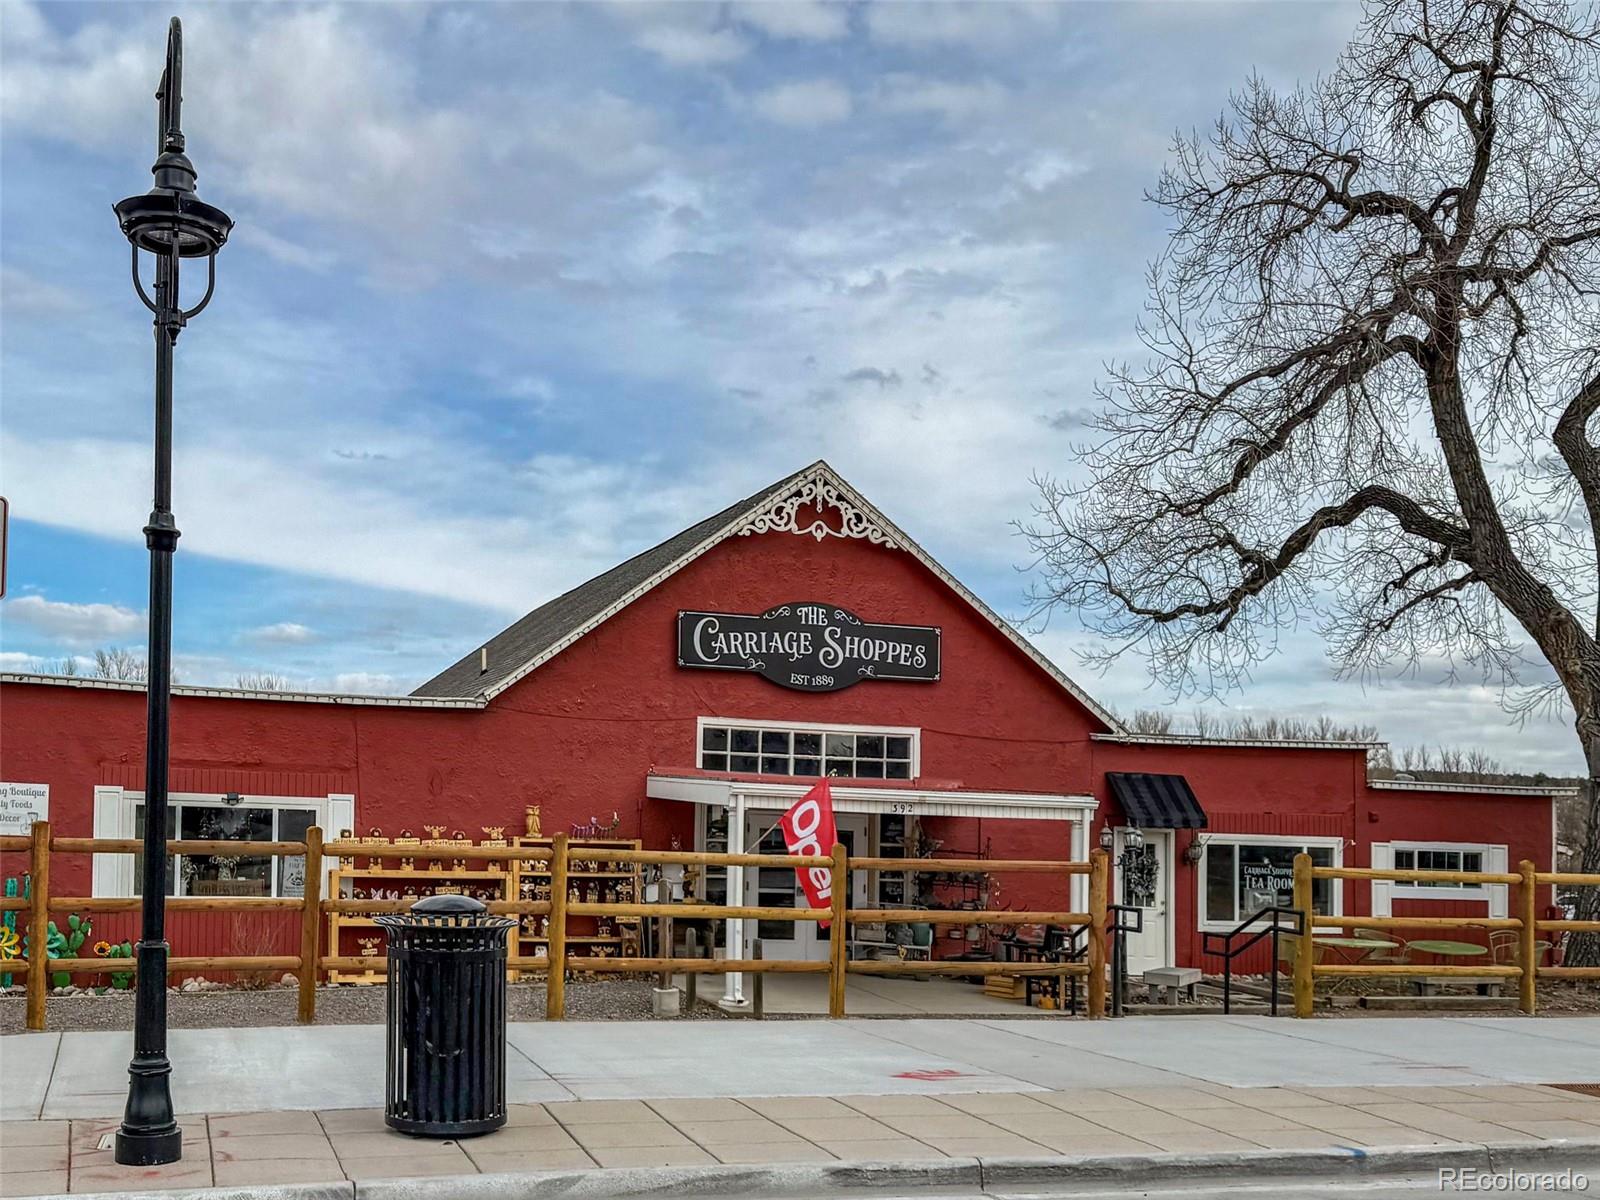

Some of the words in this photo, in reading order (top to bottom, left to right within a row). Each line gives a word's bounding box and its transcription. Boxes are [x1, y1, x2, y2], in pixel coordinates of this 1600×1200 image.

[797, 606, 828, 625] THE
[693, 617, 813, 662] CARRIAGE
[818, 626, 927, 669] SHOPPES
[790, 673, 810, 685] EST
[812, 675, 834, 687] 1889
[9, 786, 47, 799] Boutique
[1244, 875, 1264, 890] TEA
